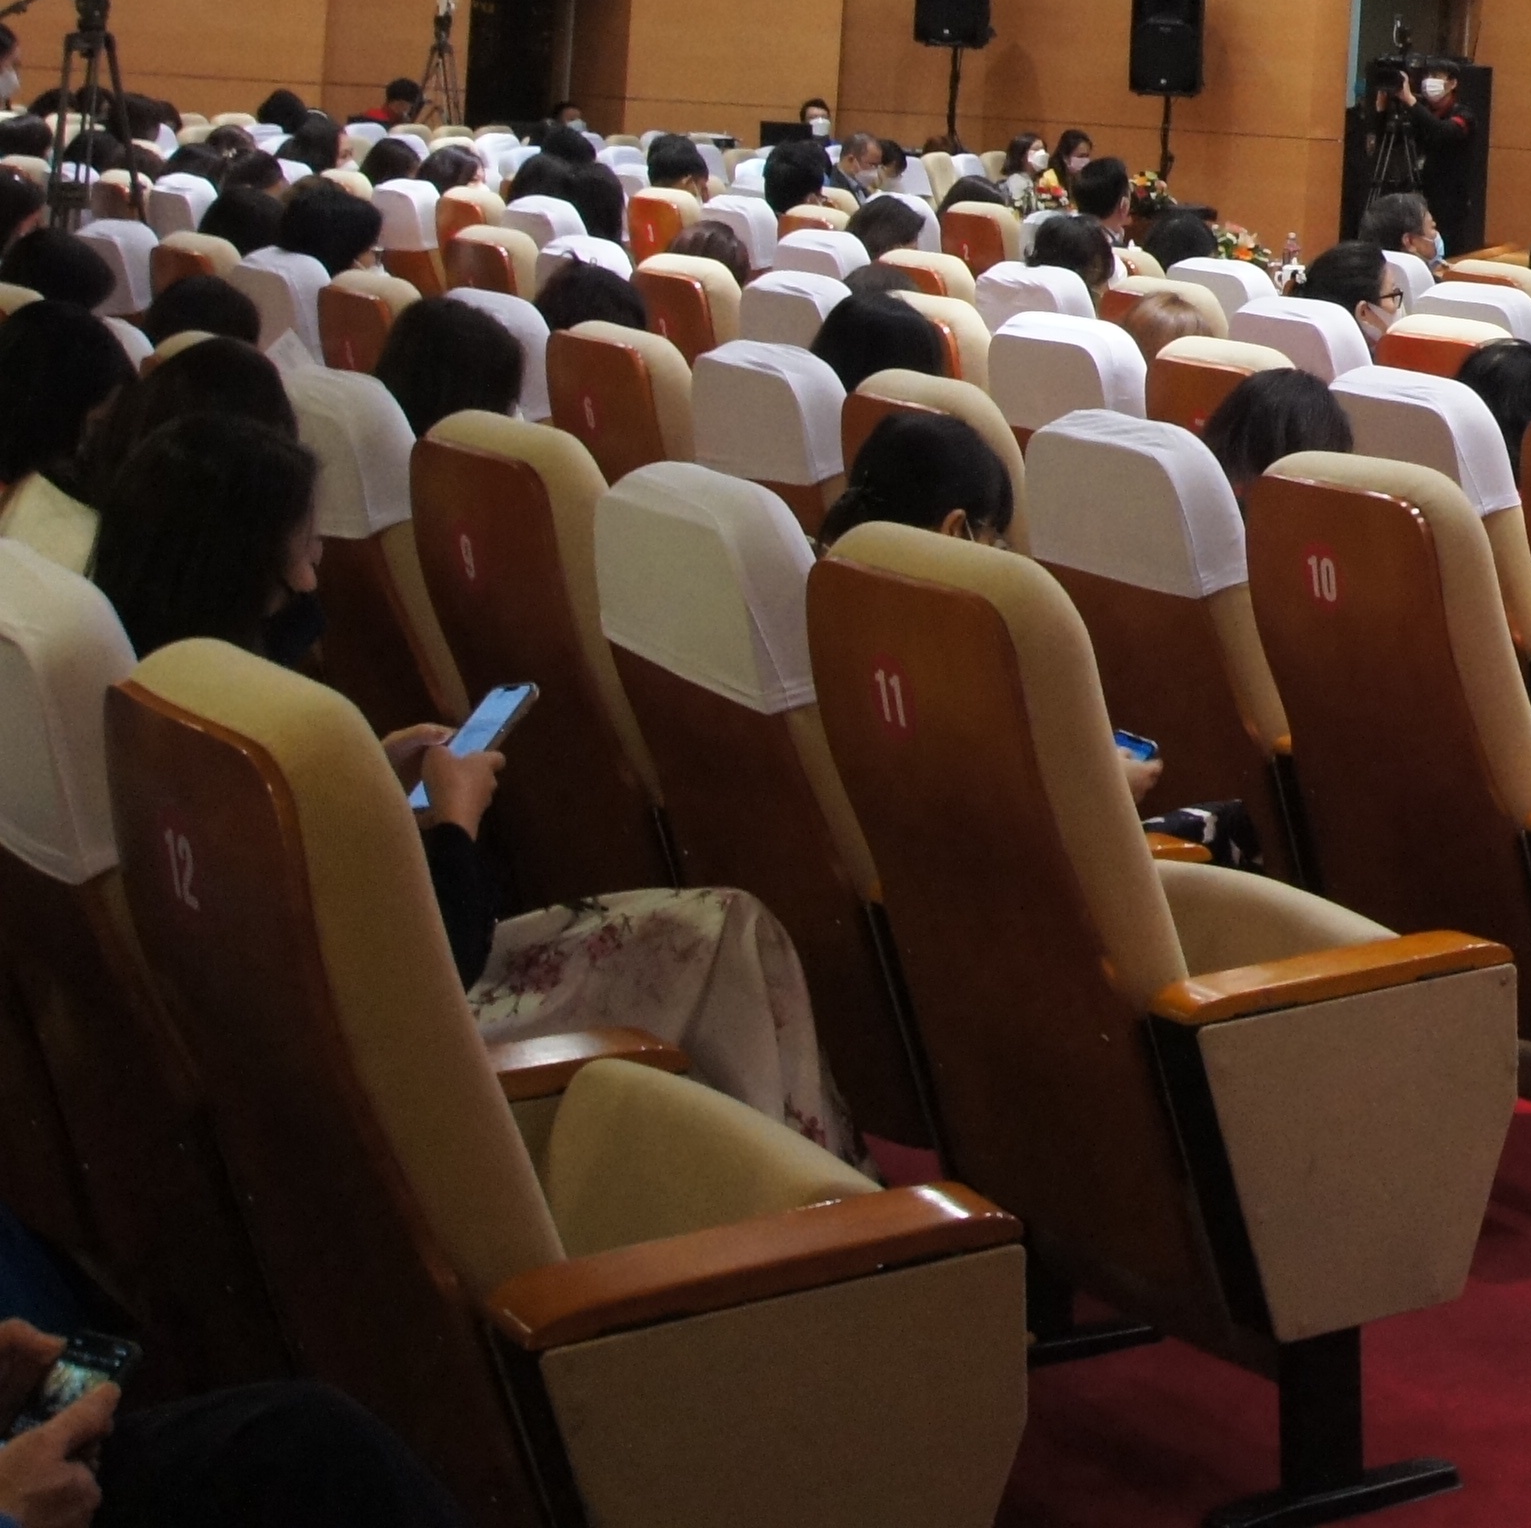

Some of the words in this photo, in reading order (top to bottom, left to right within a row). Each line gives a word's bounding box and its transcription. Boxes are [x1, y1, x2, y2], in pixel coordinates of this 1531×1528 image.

[1307, 555, 1337, 602] 10
[874, 669, 906, 728] 11
[164, 828, 200, 910] 12
